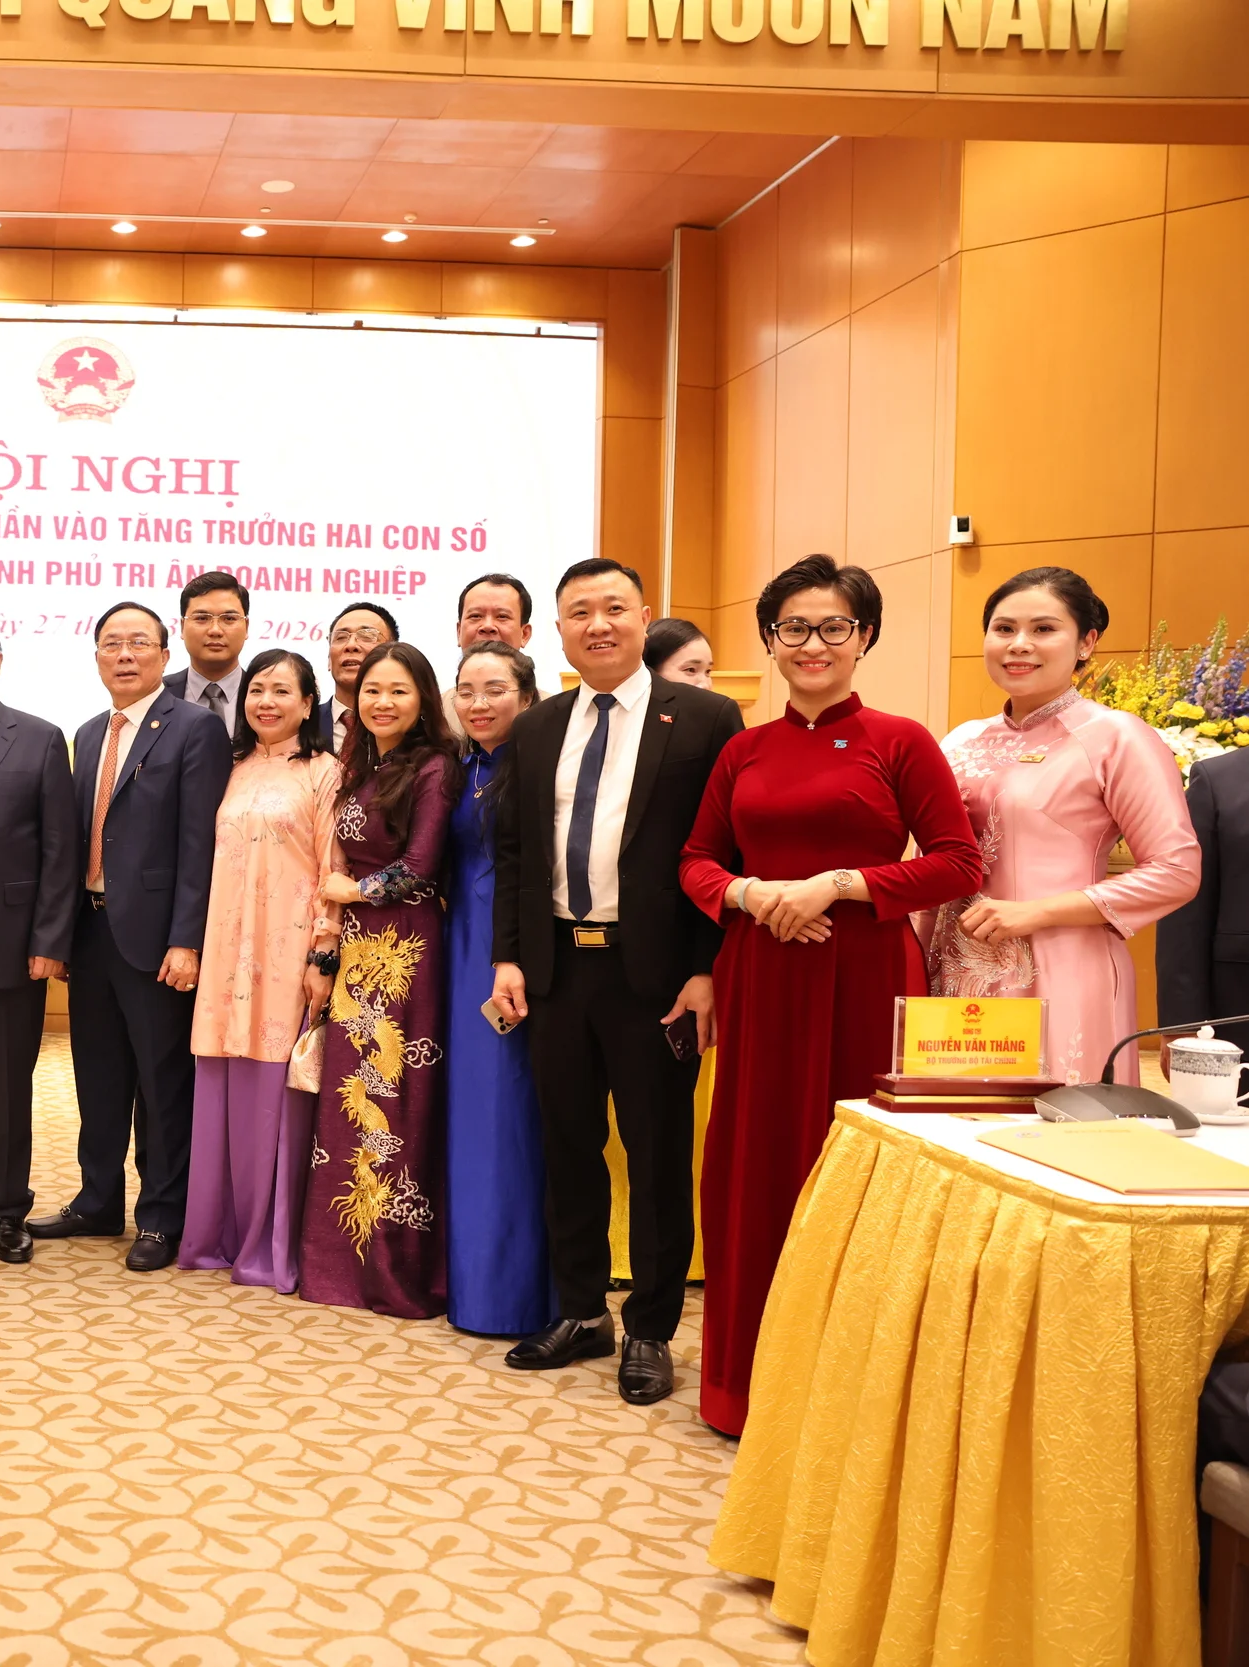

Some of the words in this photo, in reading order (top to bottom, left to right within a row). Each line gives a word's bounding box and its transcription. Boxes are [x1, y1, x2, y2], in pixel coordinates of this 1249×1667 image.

[71, 455, 240, 508] NGHỊ
[53, 511, 107, 542] VÀO
[118, 511, 192, 544] TĂNG
[203, 512, 316, 548] TRƯỞNG
[326, 523, 372, 549] HAI
[382, 524, 441, 551] CON
[451, 519, 488, 553] SỐ
[45, 553, 102, 587] PHỦ
[112, 562, 155, 588] TRI
[322, 564, 427, 601] NGHIỆP
[33, 614, 66, 635] 27
[917, 1036, 962, 1052] NGUYỄN
[964, 1037, 986, 1052] VĂN
[990, 1035, 1025, 1052] THẮNG
